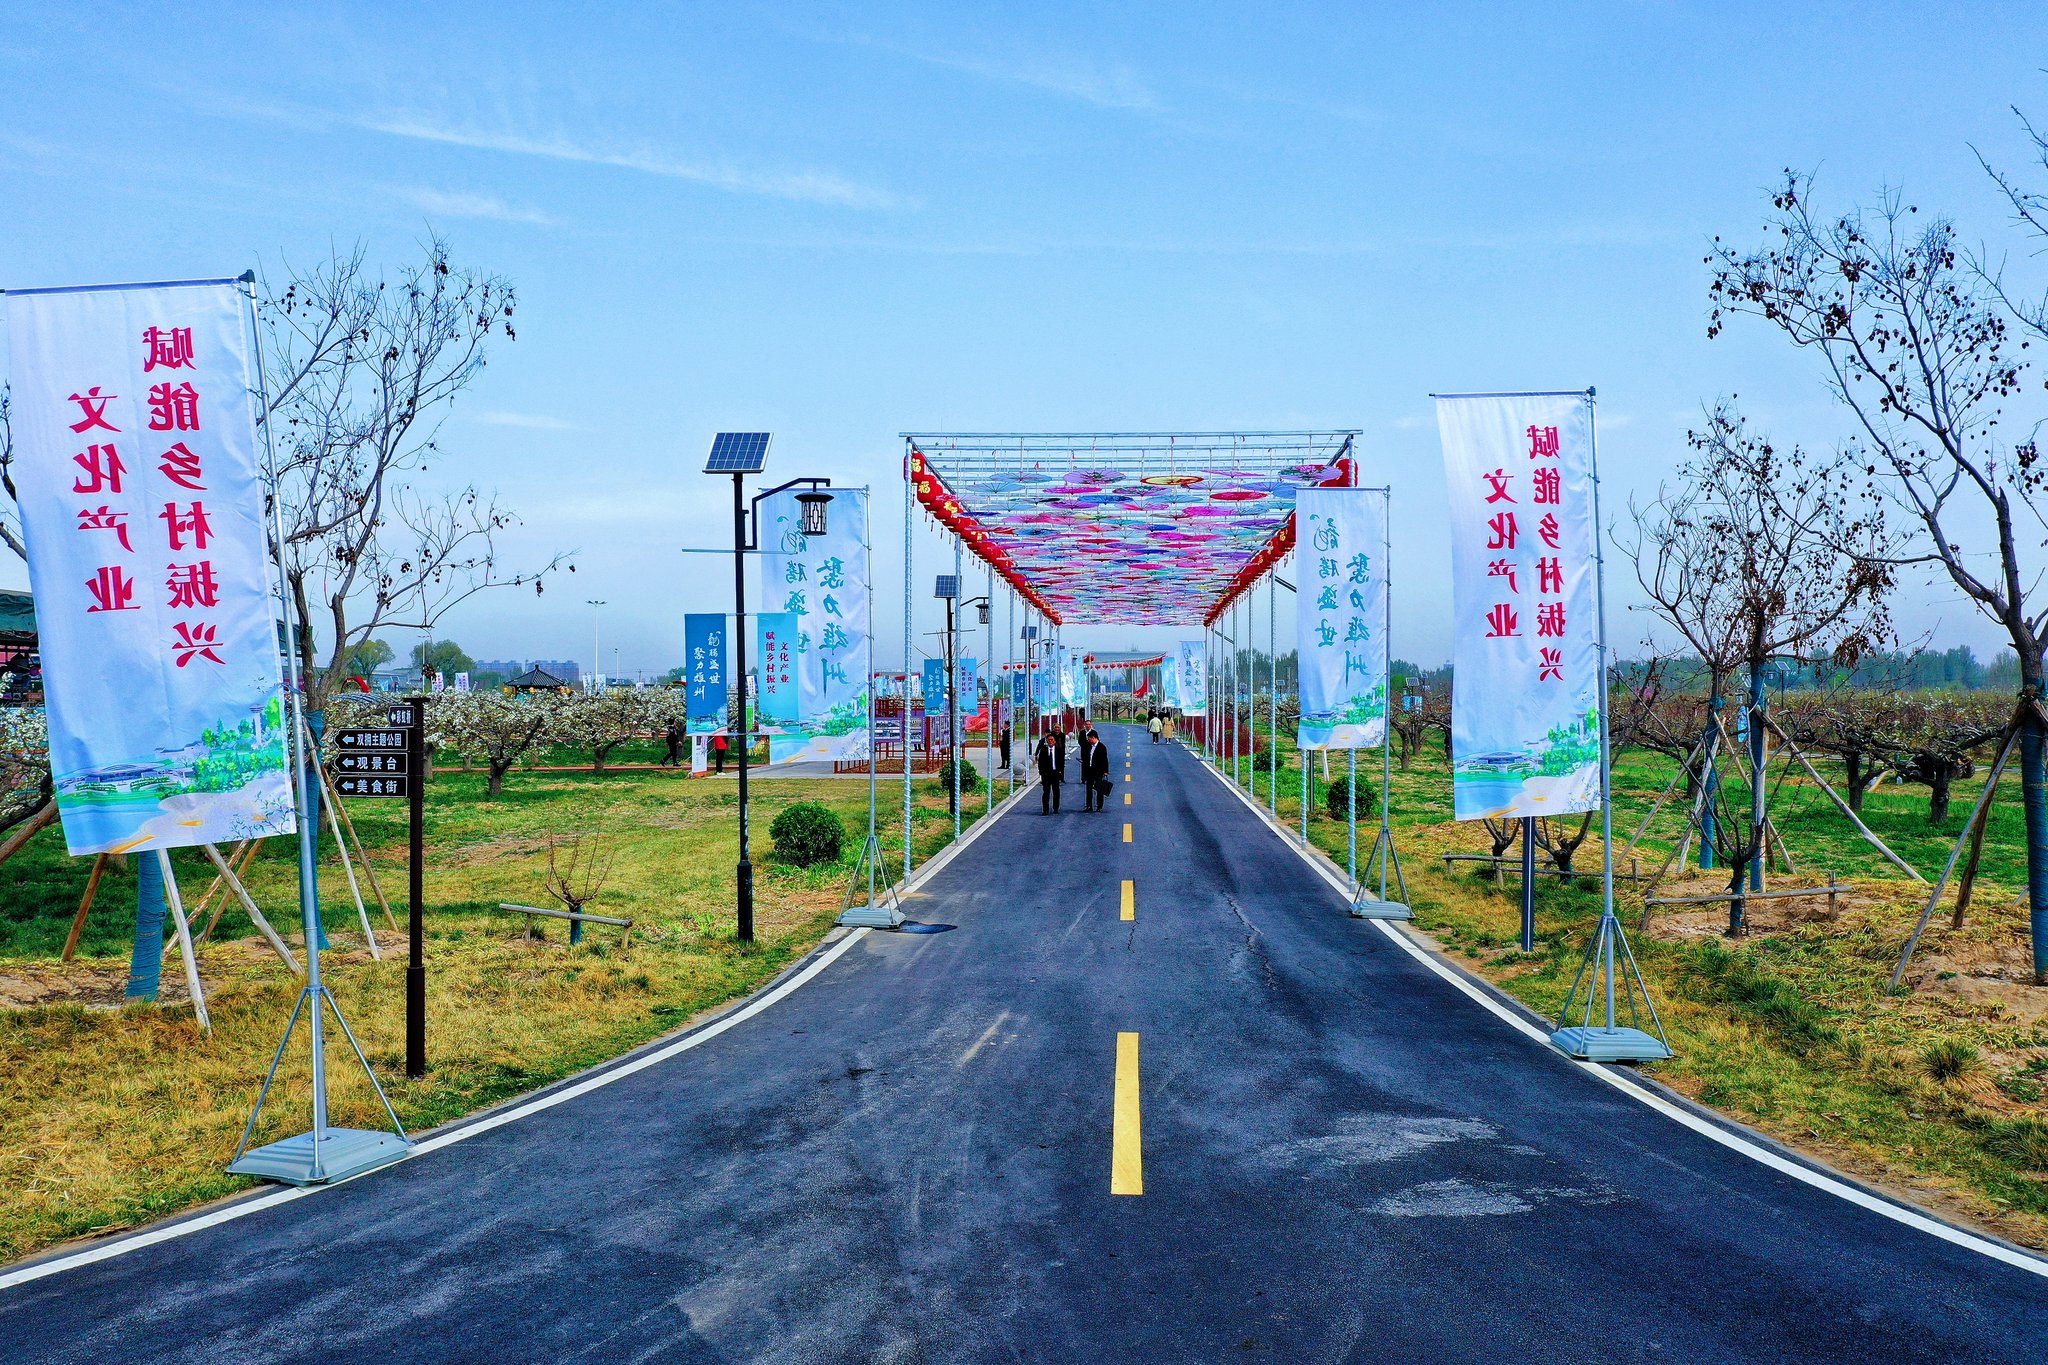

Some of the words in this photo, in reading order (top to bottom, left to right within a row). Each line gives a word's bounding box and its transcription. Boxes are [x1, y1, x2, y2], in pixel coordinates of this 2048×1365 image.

[765, 631, 776, 694] 赋能乡村振兴
[779, 642, 789, 683] 文化产业
[356, 733, 402, 747] 双拥主题公园
[356, 756, 397, 770] 观景台
[356, 779, 398, 793] 美食街
